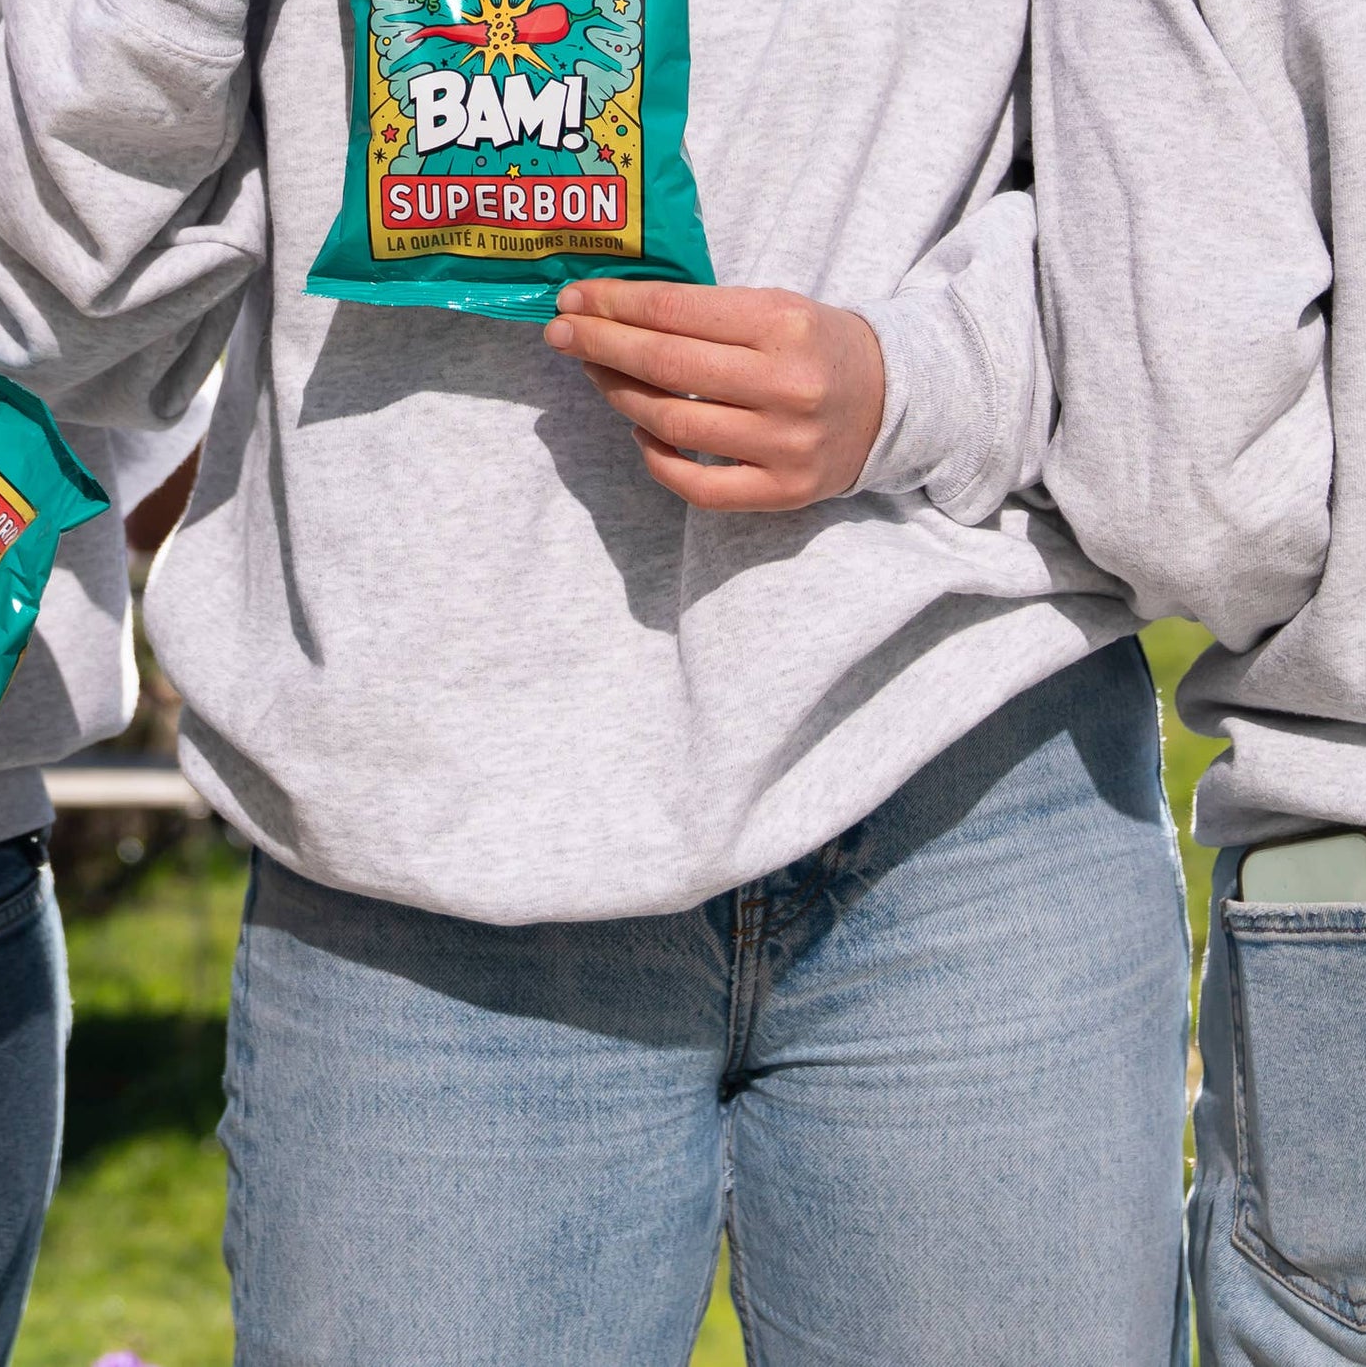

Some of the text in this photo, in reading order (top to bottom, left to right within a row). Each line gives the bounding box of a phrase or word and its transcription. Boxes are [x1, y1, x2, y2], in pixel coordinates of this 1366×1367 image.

[408, 69, 589, 155] BAM!
[388, 182, 618, 223] SUPERBON
[386, 229, 625, 253] LA QUALITÉ A TOUJOURS RAISON
